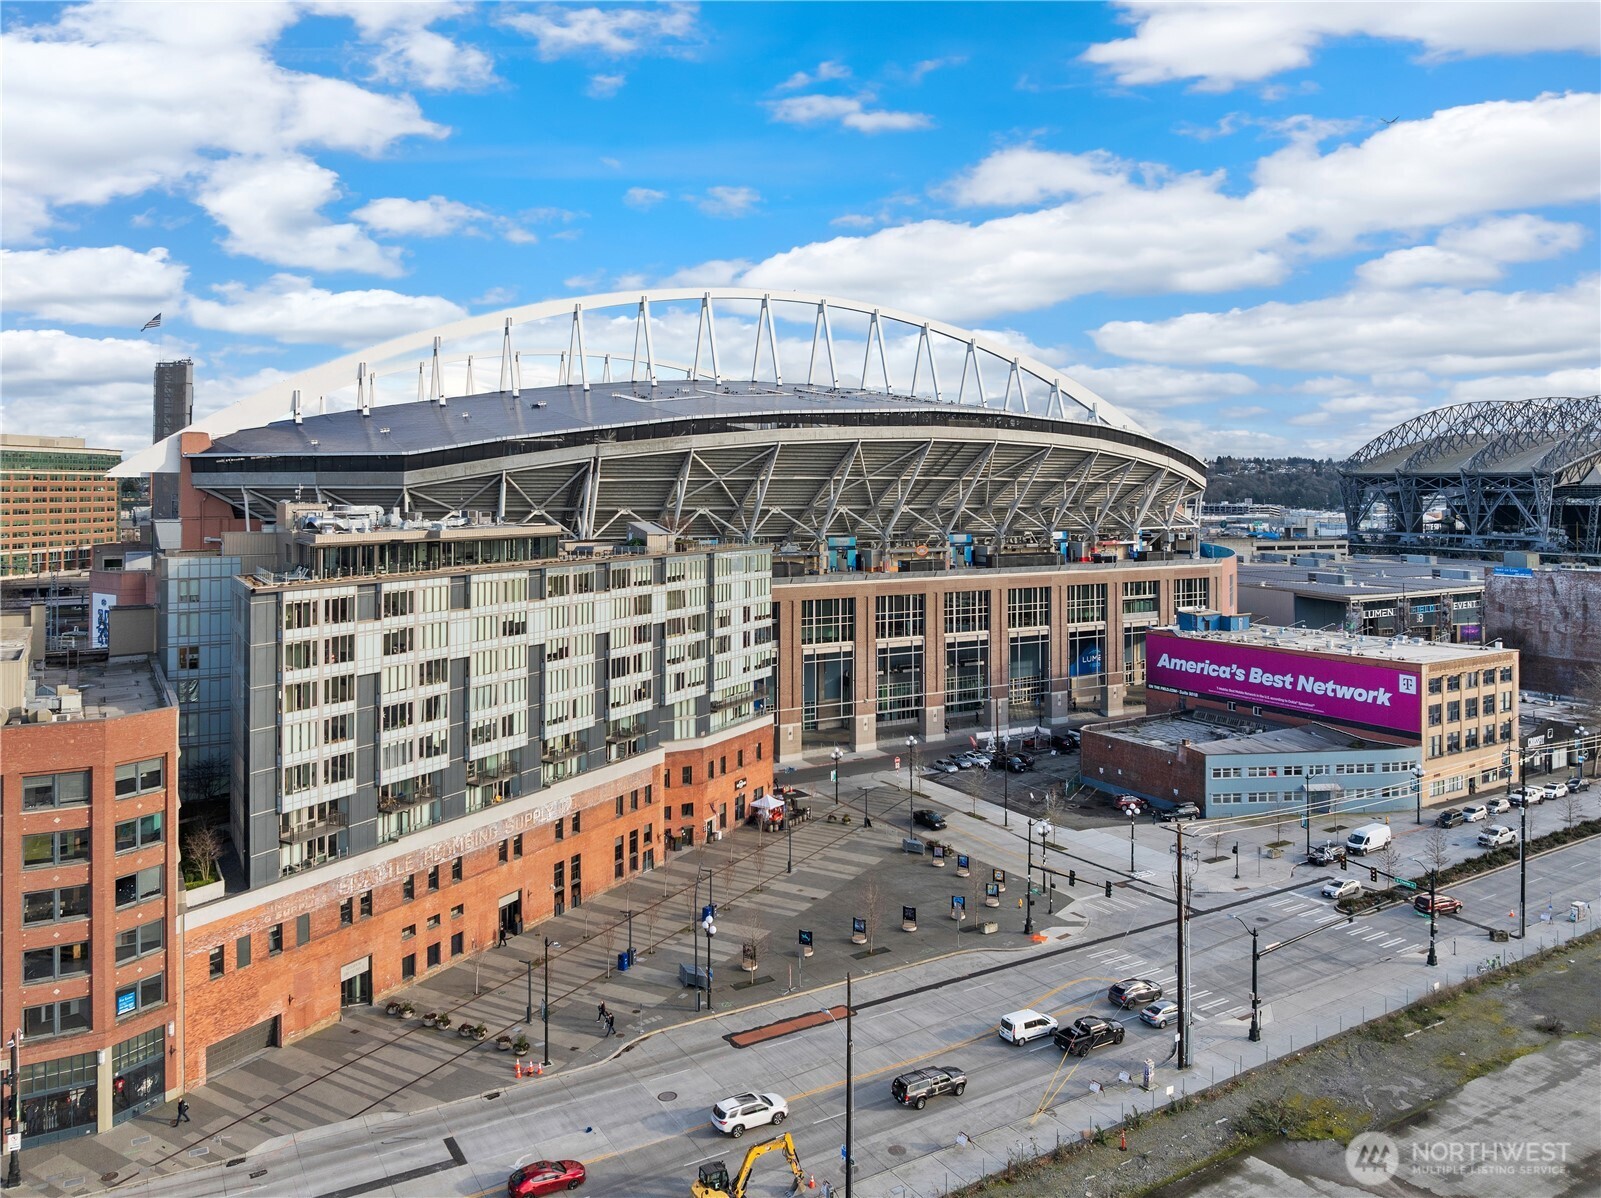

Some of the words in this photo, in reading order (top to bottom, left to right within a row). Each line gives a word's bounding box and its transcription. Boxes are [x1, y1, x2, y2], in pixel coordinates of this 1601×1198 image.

[1363, 608, 1394, 619] LUMEN
[1453, 600, 1477, 610] EVENT
[1156, 653, 1246, 682] America's
[1248, 666, 1294, 690] Best
[1296, 674, 1393, 707] Network
[505, 801, 554, 834] SUPPLY
